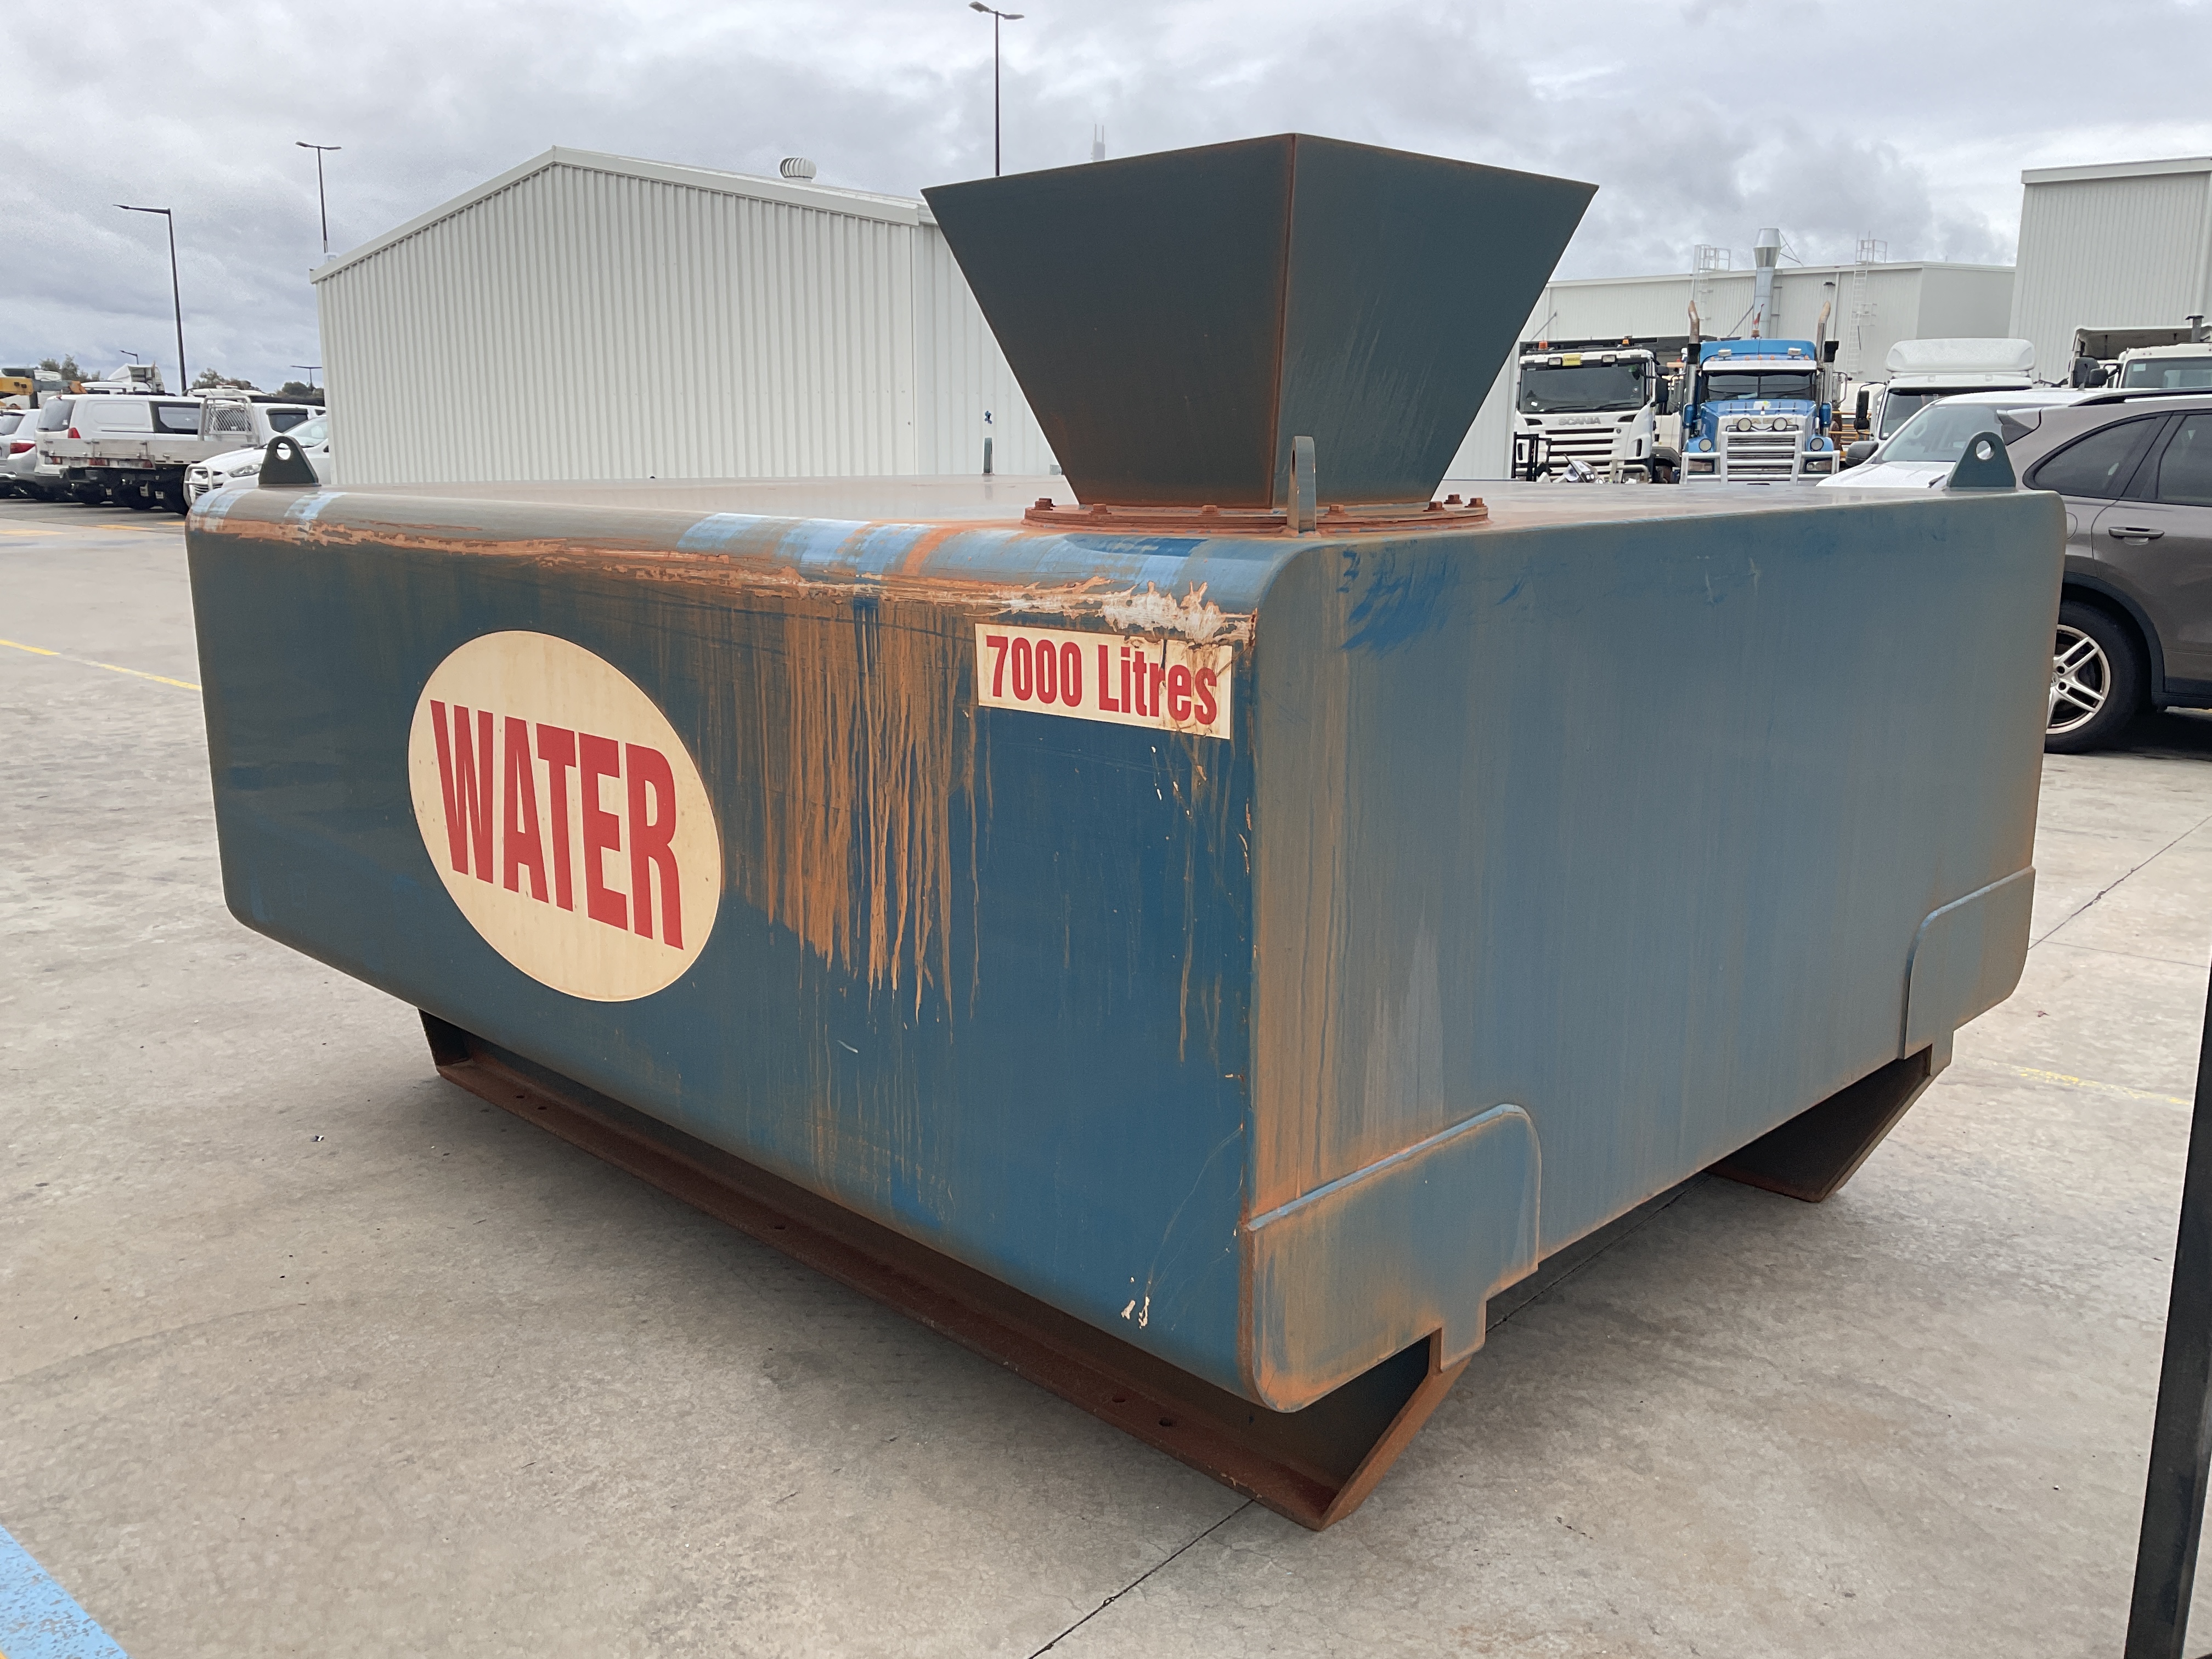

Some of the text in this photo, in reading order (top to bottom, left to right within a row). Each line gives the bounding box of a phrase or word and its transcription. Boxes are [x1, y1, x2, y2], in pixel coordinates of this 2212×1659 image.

[1559, 417, 1601, 425] SCANIA
[986, 635, 1217, 725] 7000 Litres
[430, 699, 684, 950] WATER
